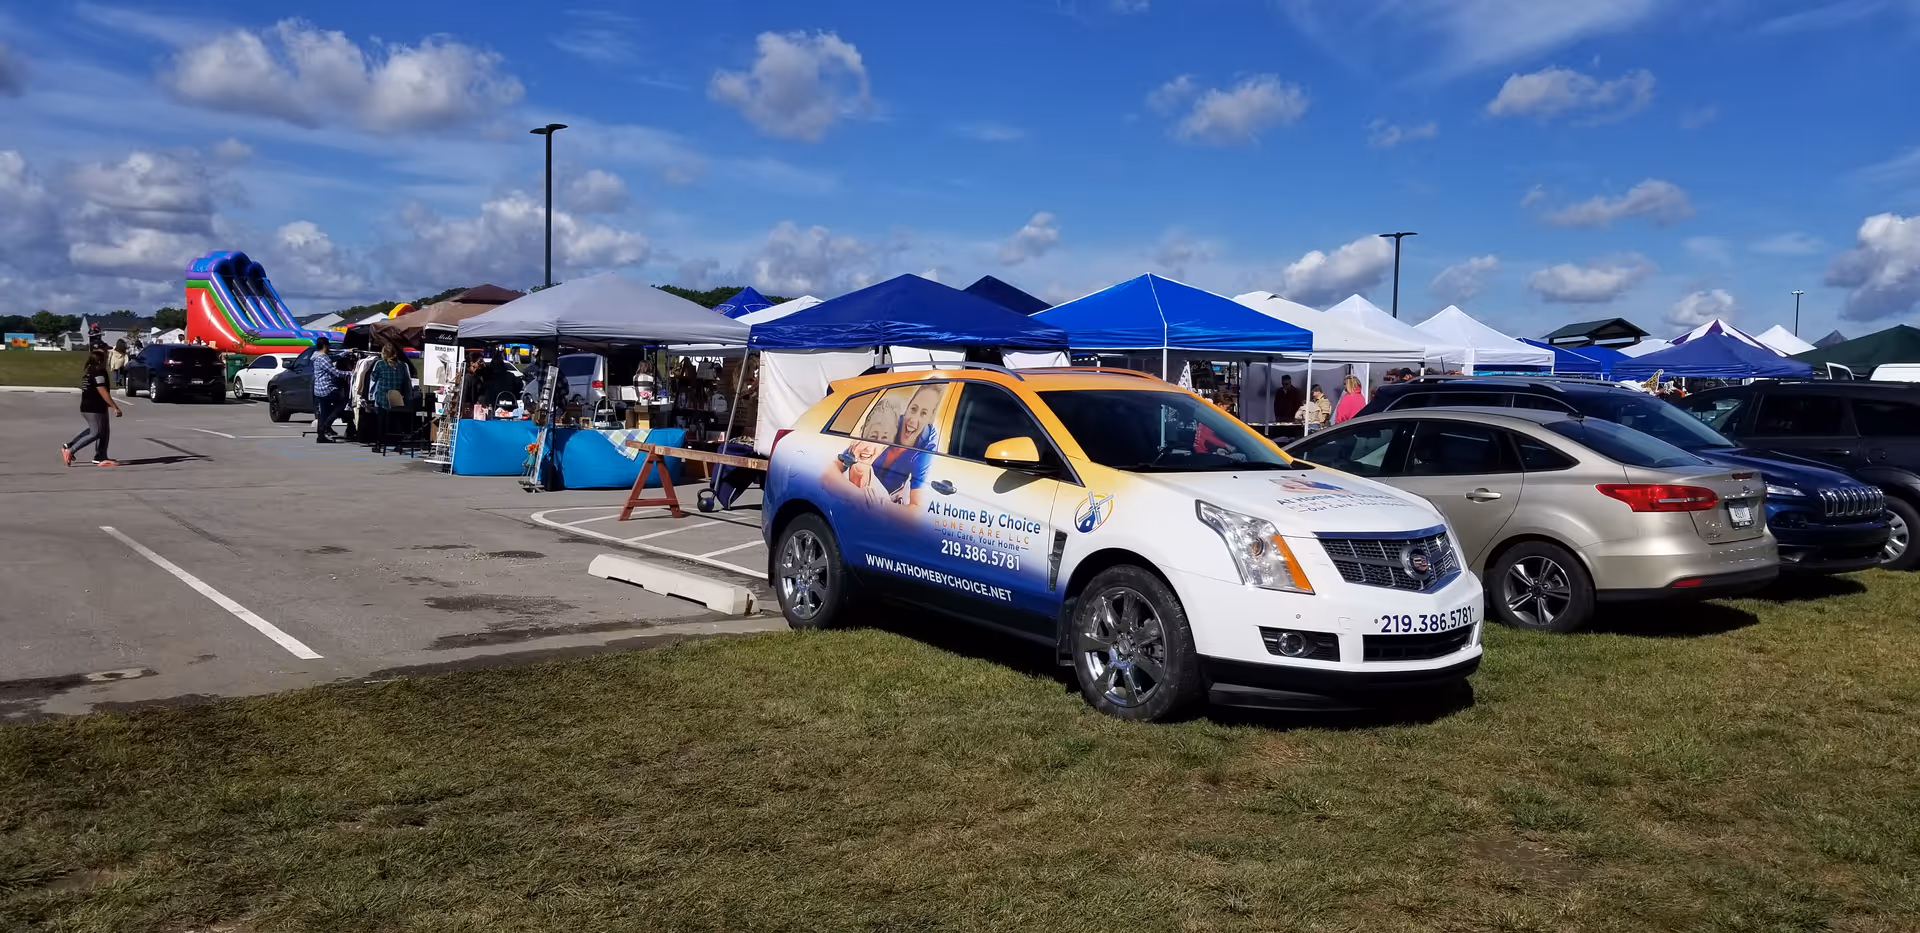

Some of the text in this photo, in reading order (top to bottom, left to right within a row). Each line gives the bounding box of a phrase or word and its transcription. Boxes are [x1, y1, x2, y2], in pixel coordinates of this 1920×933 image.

[928, 500, 1041, 534] At Home By Choice
[934, 519, 1030, 545] HOME CARE LLC
[941, 528, 1020, 552] Our Care, Your Home
[941, 539, 1021, 571] 219.386.5781
[865, 553, 1012, 602] WWW.ATHOMEBYCHOICE.NET
[1381, 605, 1473, 633] 219.386.5781
